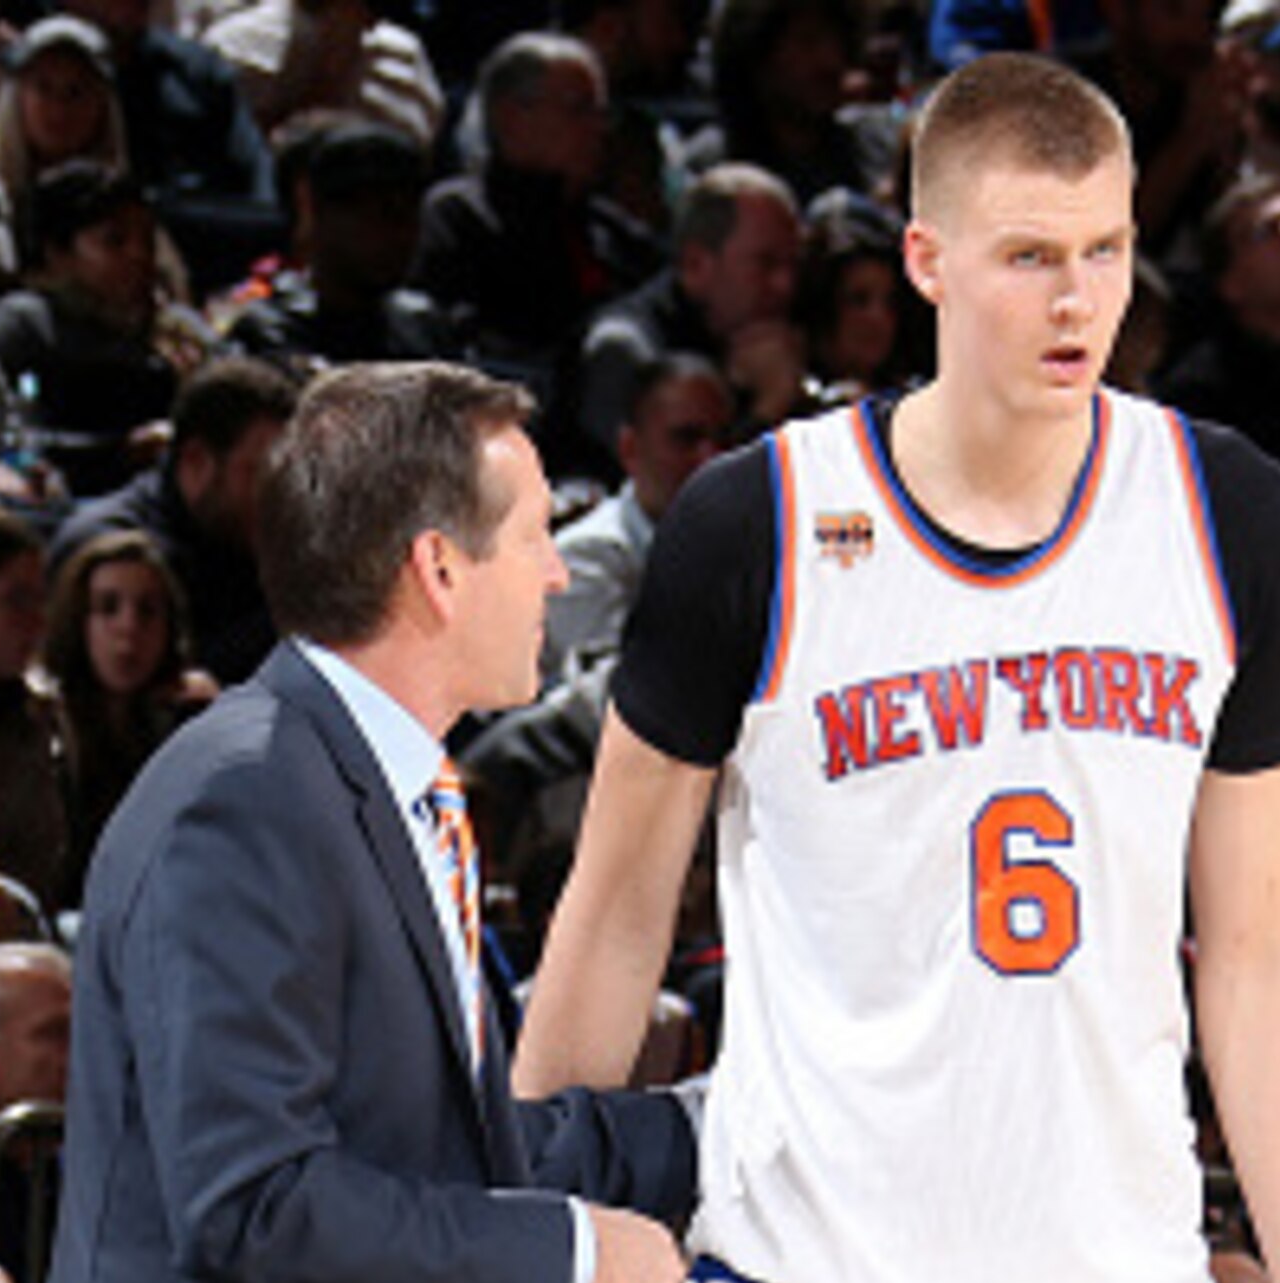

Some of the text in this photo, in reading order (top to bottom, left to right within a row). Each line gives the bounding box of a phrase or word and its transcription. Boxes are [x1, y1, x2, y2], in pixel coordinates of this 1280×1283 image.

[815, 646, 1205, 782] NEW YORK
[969, 787, 1080, 978] 6
